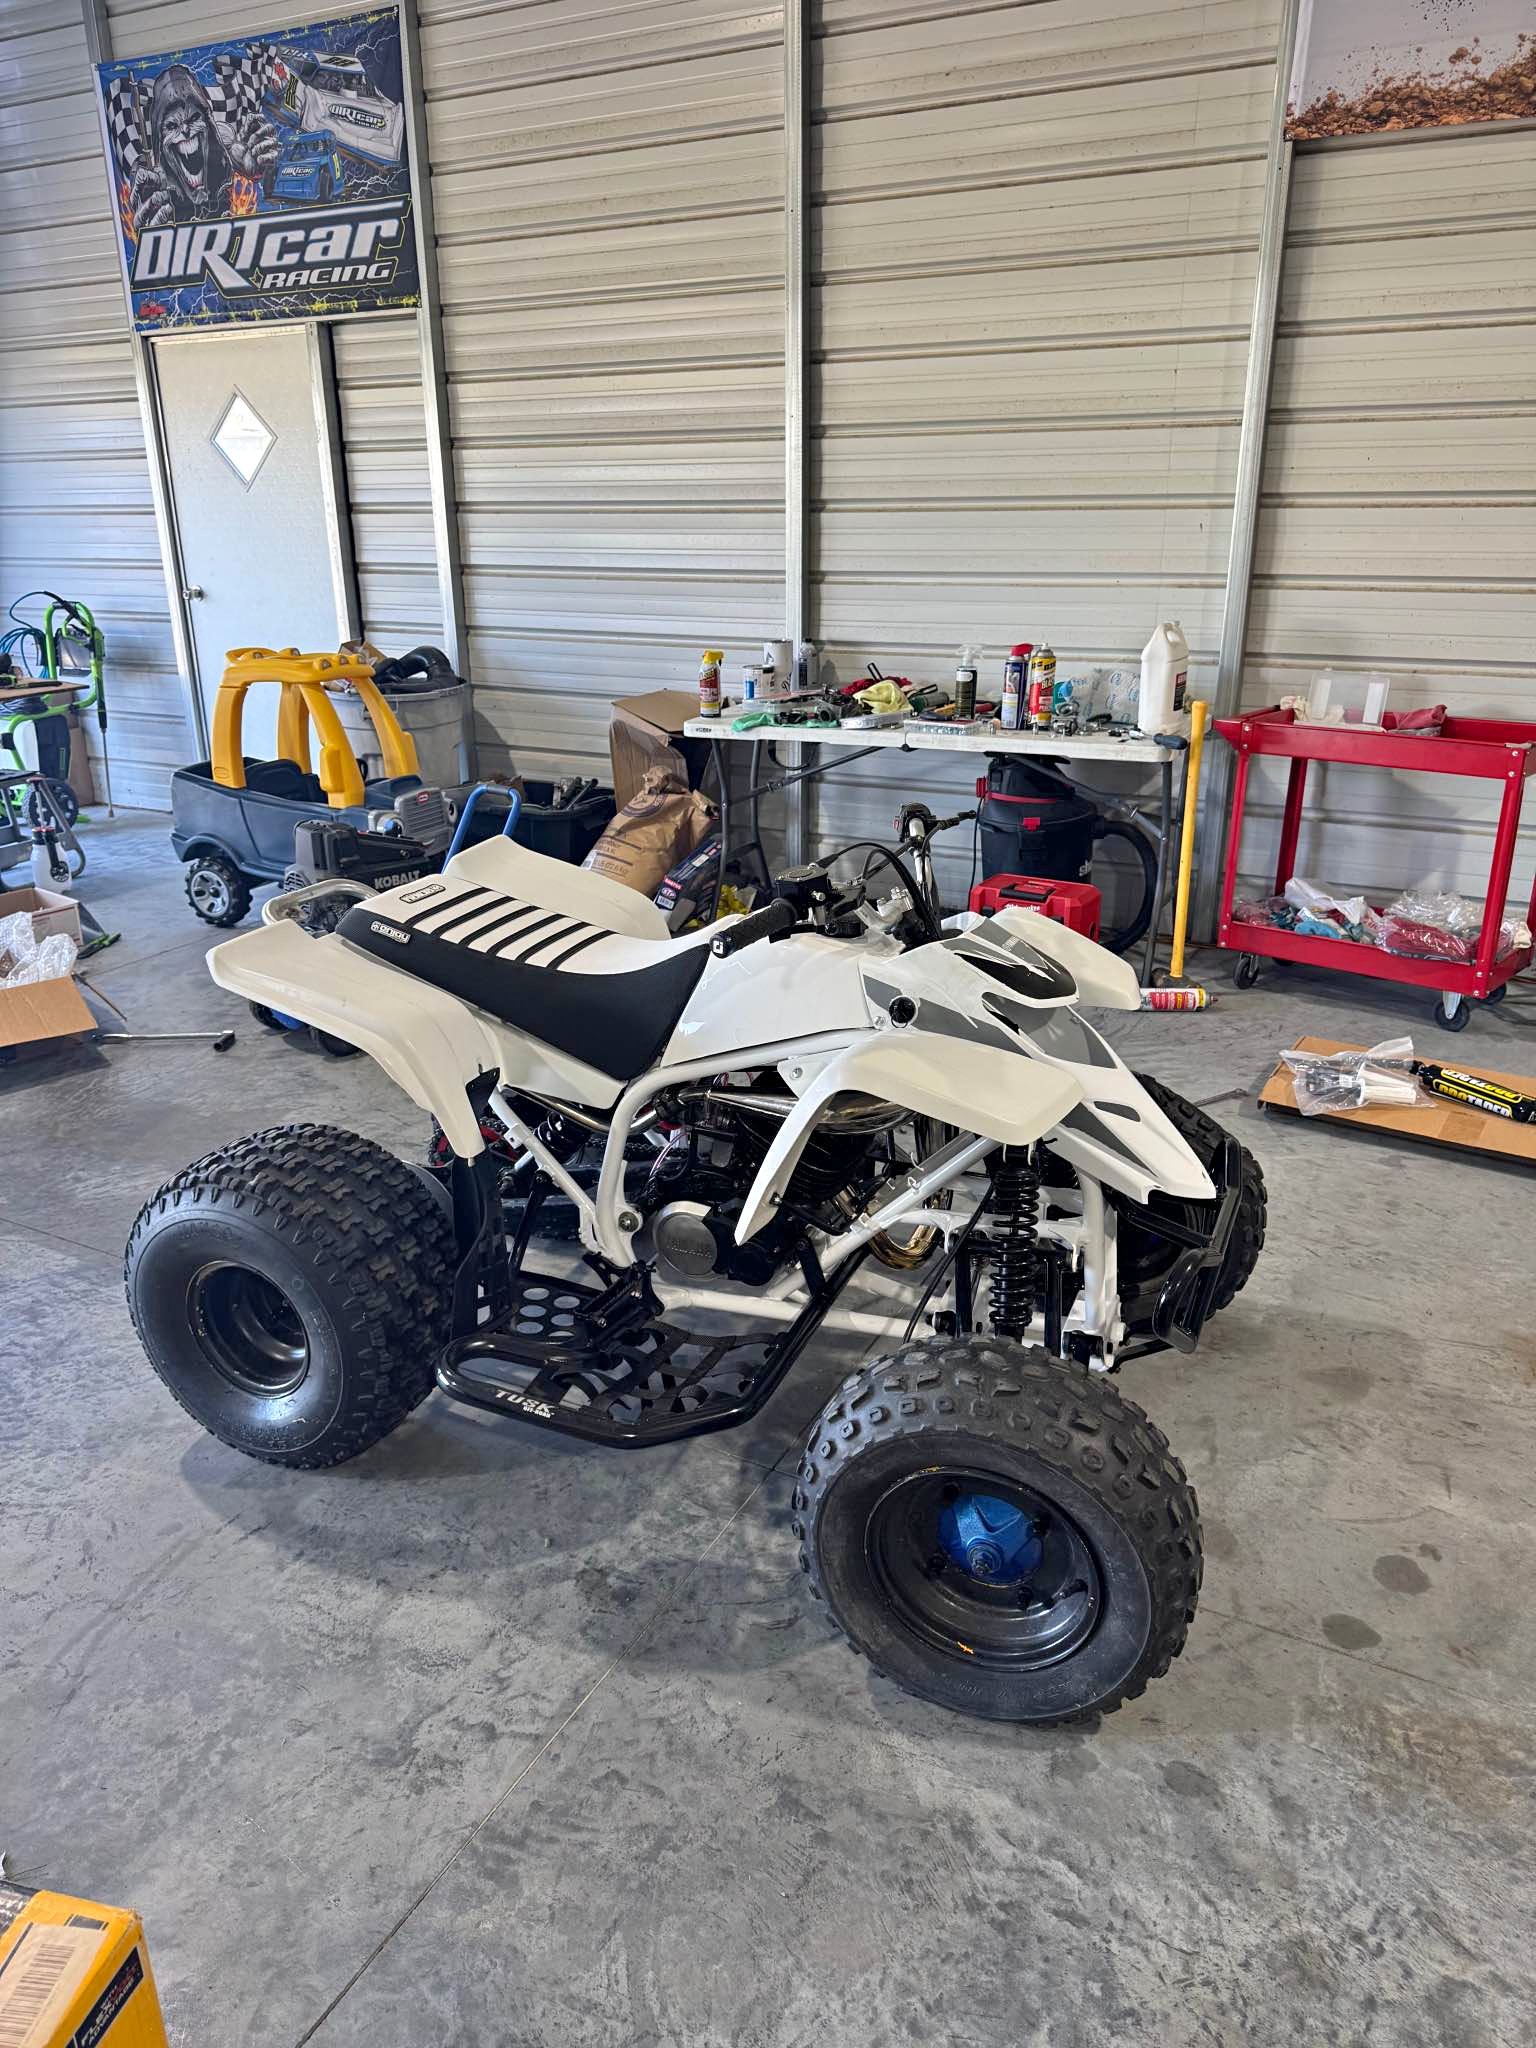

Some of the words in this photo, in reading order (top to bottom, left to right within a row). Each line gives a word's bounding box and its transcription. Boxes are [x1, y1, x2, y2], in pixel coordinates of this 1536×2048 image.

[133, 199, 405, 290] DIRTcar
[262, 261, 393, 290] RACING
[374, 870, 420, 889] KOBALT
[495, 1389, 556, 1413] TUSK
